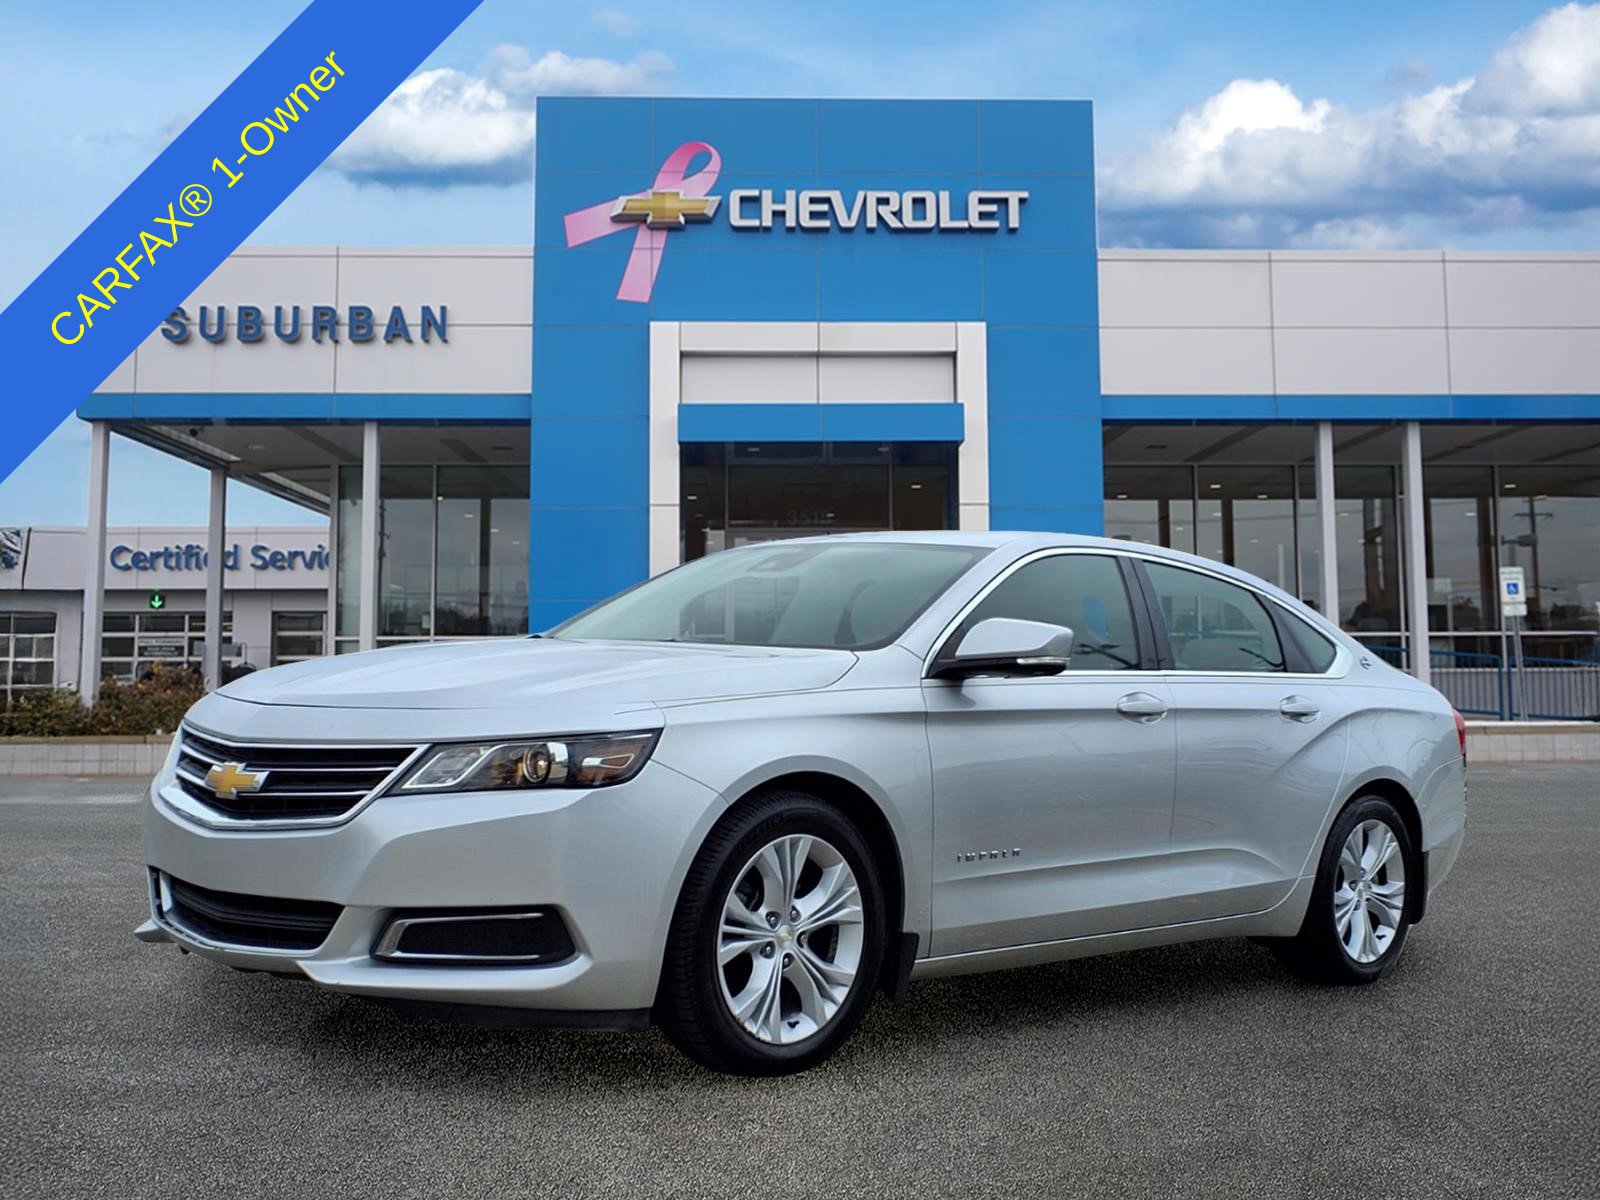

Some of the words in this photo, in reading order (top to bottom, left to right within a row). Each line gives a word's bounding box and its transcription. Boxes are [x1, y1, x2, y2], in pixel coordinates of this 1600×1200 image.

[729, 189, 1029, 231] CHEVROLET
[161, 305, 449, 344] SUBURBAN
[110, 544, 240, 571] Certifid
